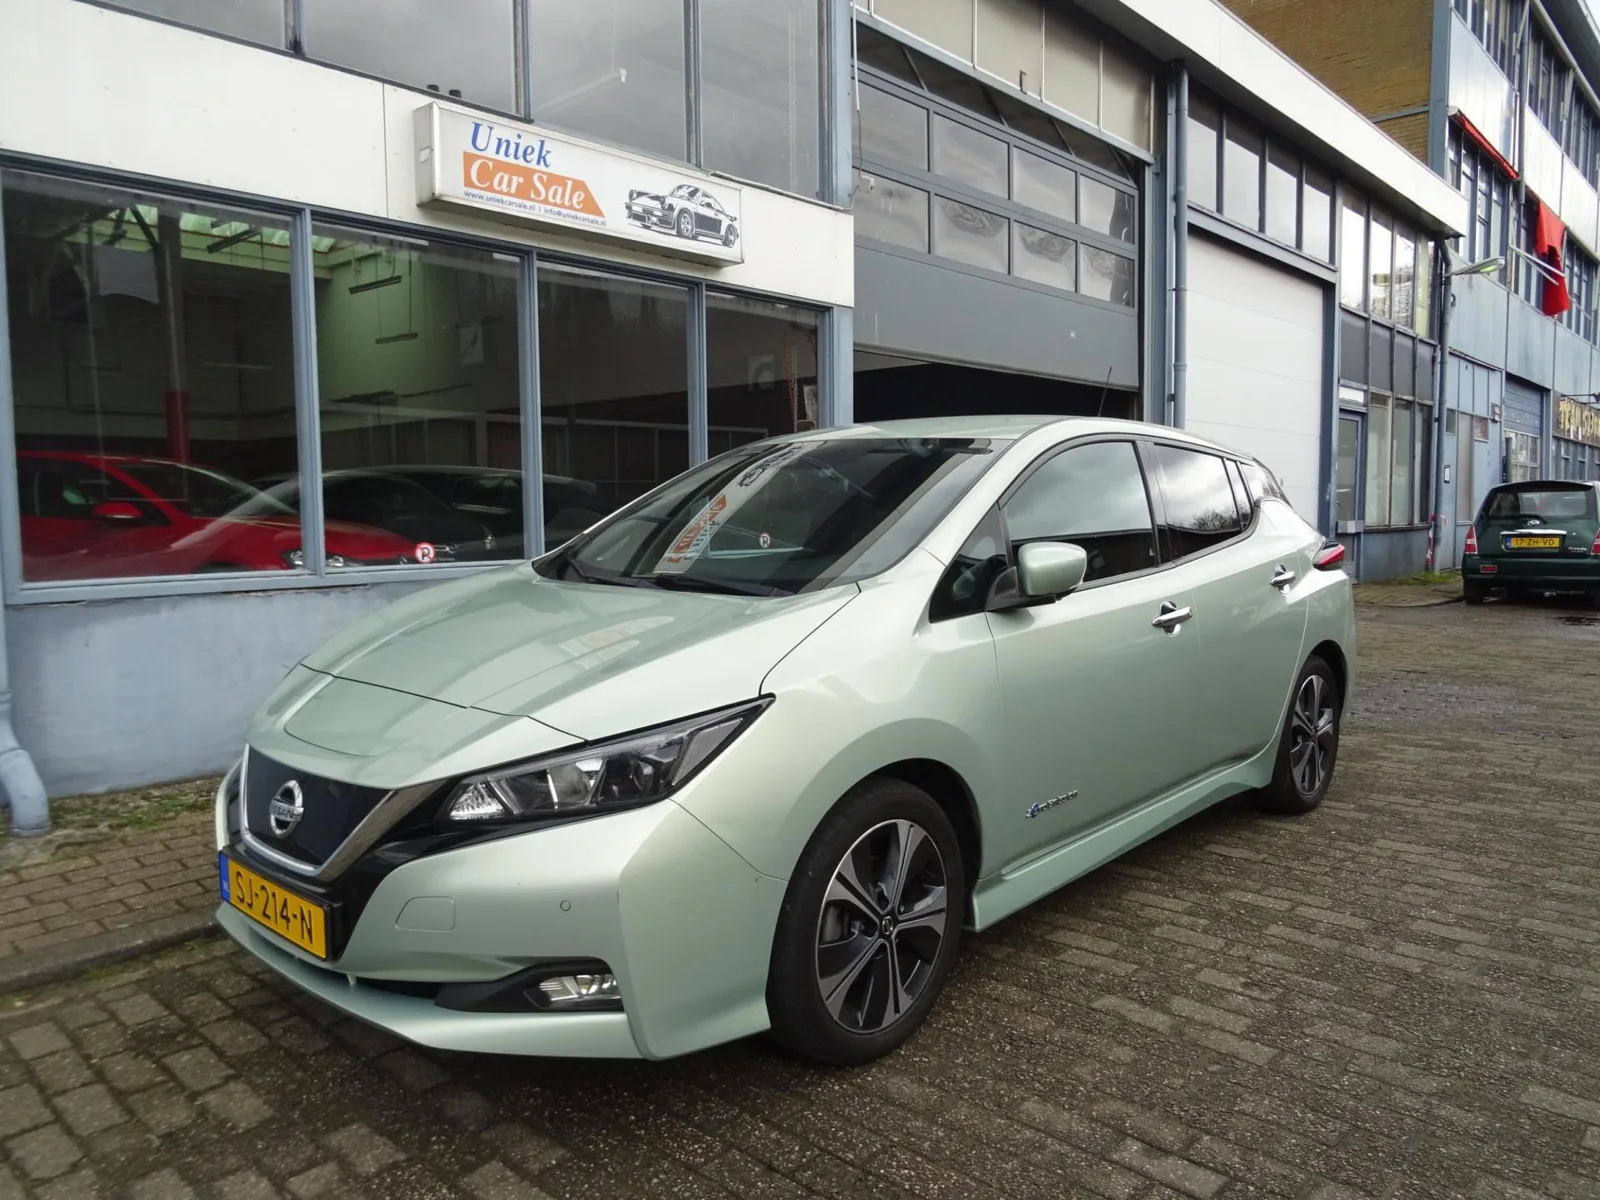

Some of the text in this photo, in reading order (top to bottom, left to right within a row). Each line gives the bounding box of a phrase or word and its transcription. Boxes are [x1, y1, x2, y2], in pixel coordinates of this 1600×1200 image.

[471, 122, 551, 168] Uniek
[470, 158, 585, 209] Car Sale
[464, 190, 536, 211] www.uniekcarsale.nl
[543, 207, 606, 226] info@uniekcarsale.nl
[236, 871, 313, 944] SJ-214-N
